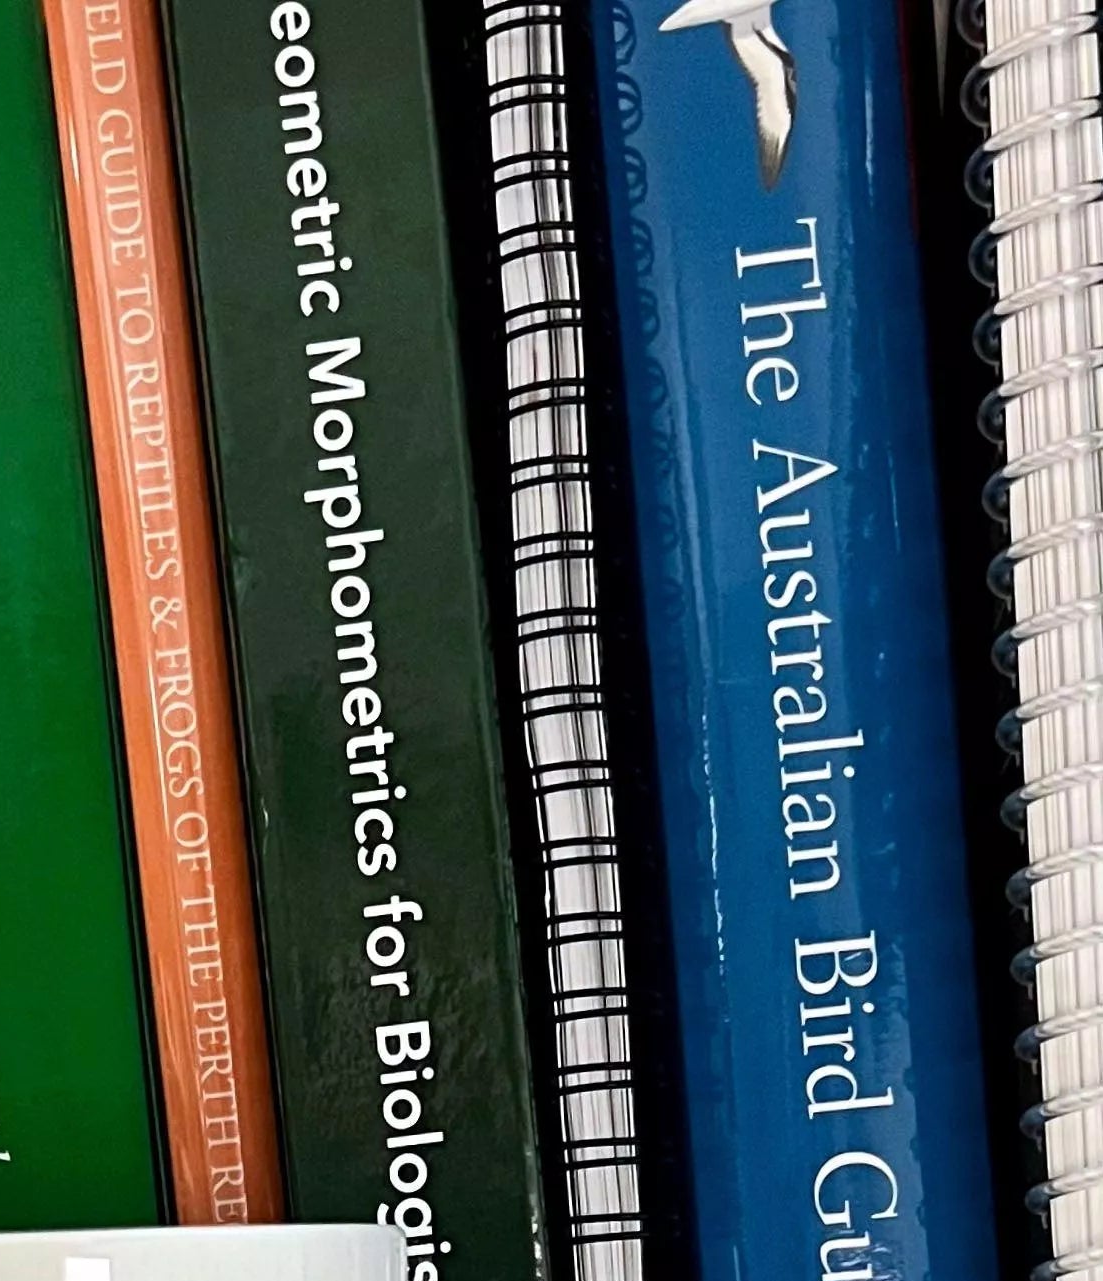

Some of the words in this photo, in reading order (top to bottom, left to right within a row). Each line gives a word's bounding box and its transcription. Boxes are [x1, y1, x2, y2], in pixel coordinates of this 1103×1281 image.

[83, 2, 128, 95] ELD
[97, 109, 149, 267] GUIDE
[268, 1, 353, 318] eometric
[114, 273, 155, 346] TO
[735, 216, 828, 407] The
[123, 360, 182, 583] REPTILES
[149, 595, 184, 633] &
[302, 336, 407, 878] Morphometrics
[751, 437, 866, 900] Australian
[154, 642, 205, 799] FROGS
[173, 811, 212, 874] OF
[179, 881, 225, 986] THE
[362, 894, 423, 998] for
[192, 997, 241, 1150] PERTH
[793, 929, 895, 1120] Bird
[210, 1163, 249, 1226] RE
